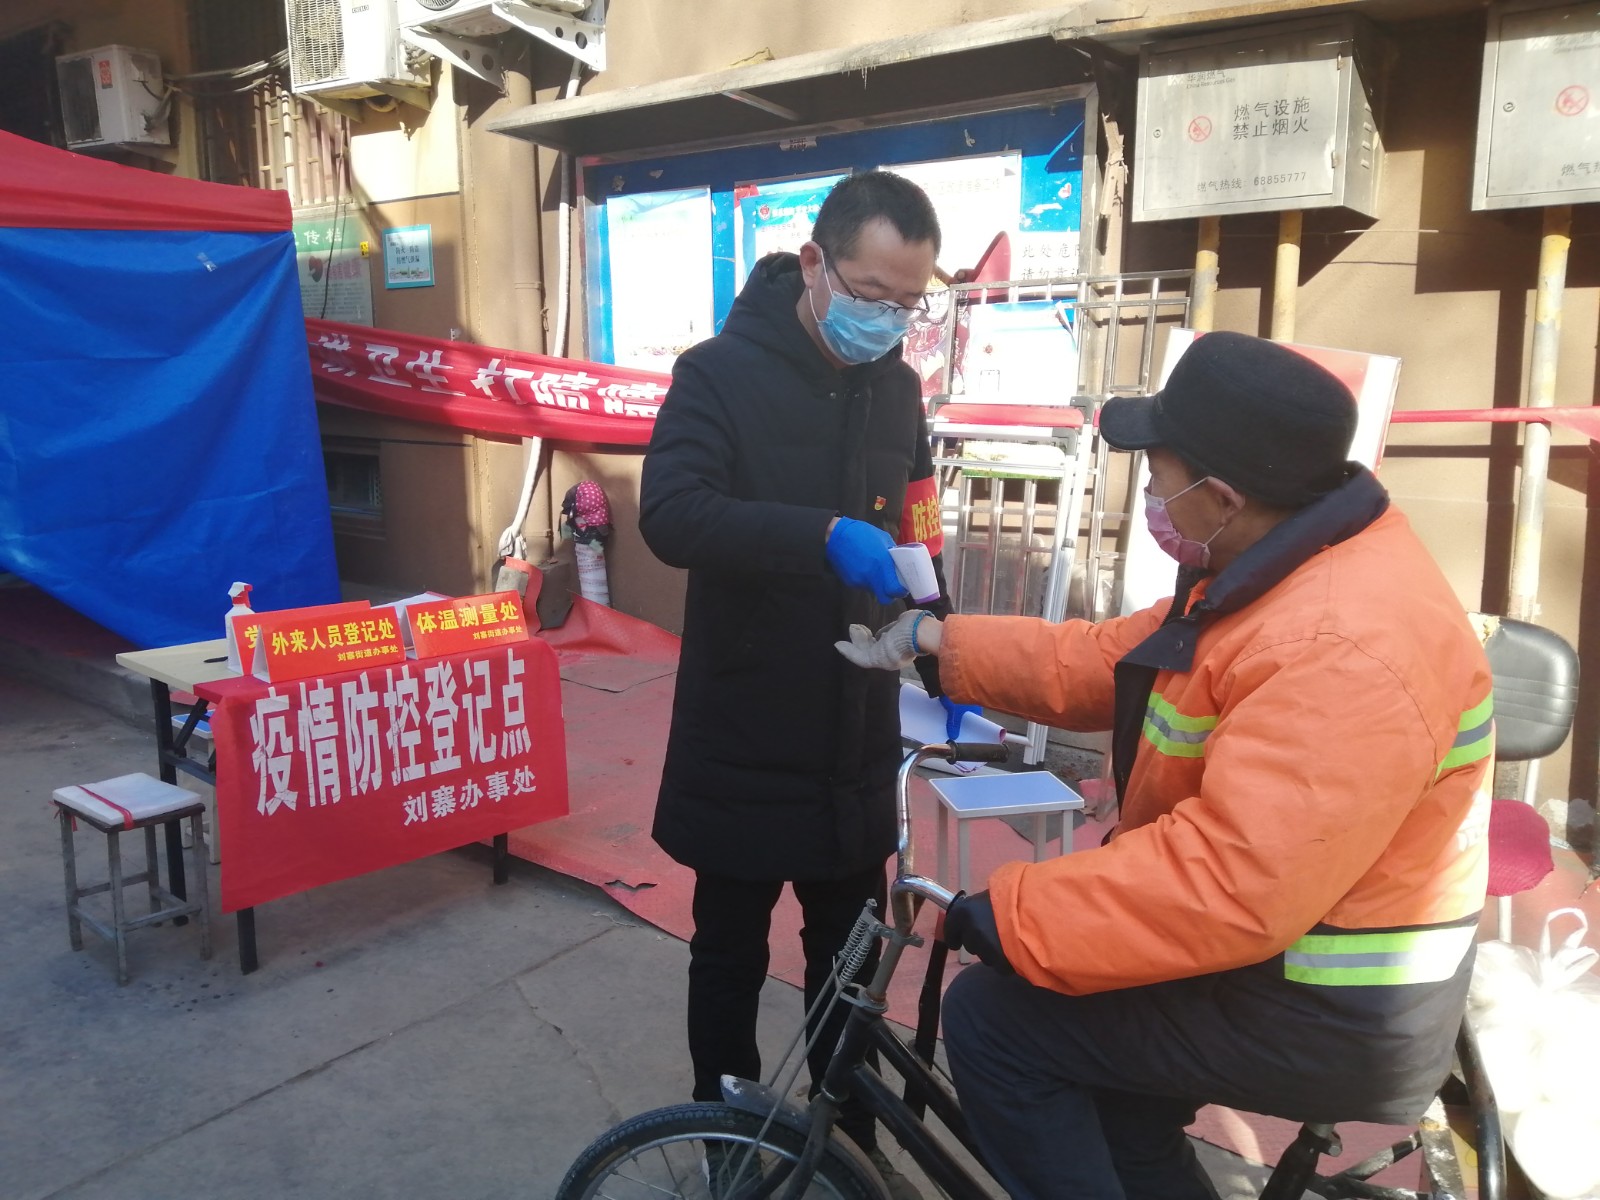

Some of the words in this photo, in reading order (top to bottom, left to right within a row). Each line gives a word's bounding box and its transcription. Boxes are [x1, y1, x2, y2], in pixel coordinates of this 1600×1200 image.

[1233, 96, 1311, 122] 燃气设施
[1232, 115, 1310, 141] 禁止烟火
[293, 228, 342, 246] 传栏
[911, 494, 942, 542] 防控
[416, 600, 520, 635] 体温测量处
[271, 617, 396, 656] 外来人员登记处
[472, 625, 524, 641] 刘寨街道办事处
[337, 644, 399, 662] 刘寨街道办事处
[250, 648, 532, 817] 疫情防控登记点
[402, 764, 538, 827] 刘寨办事处
